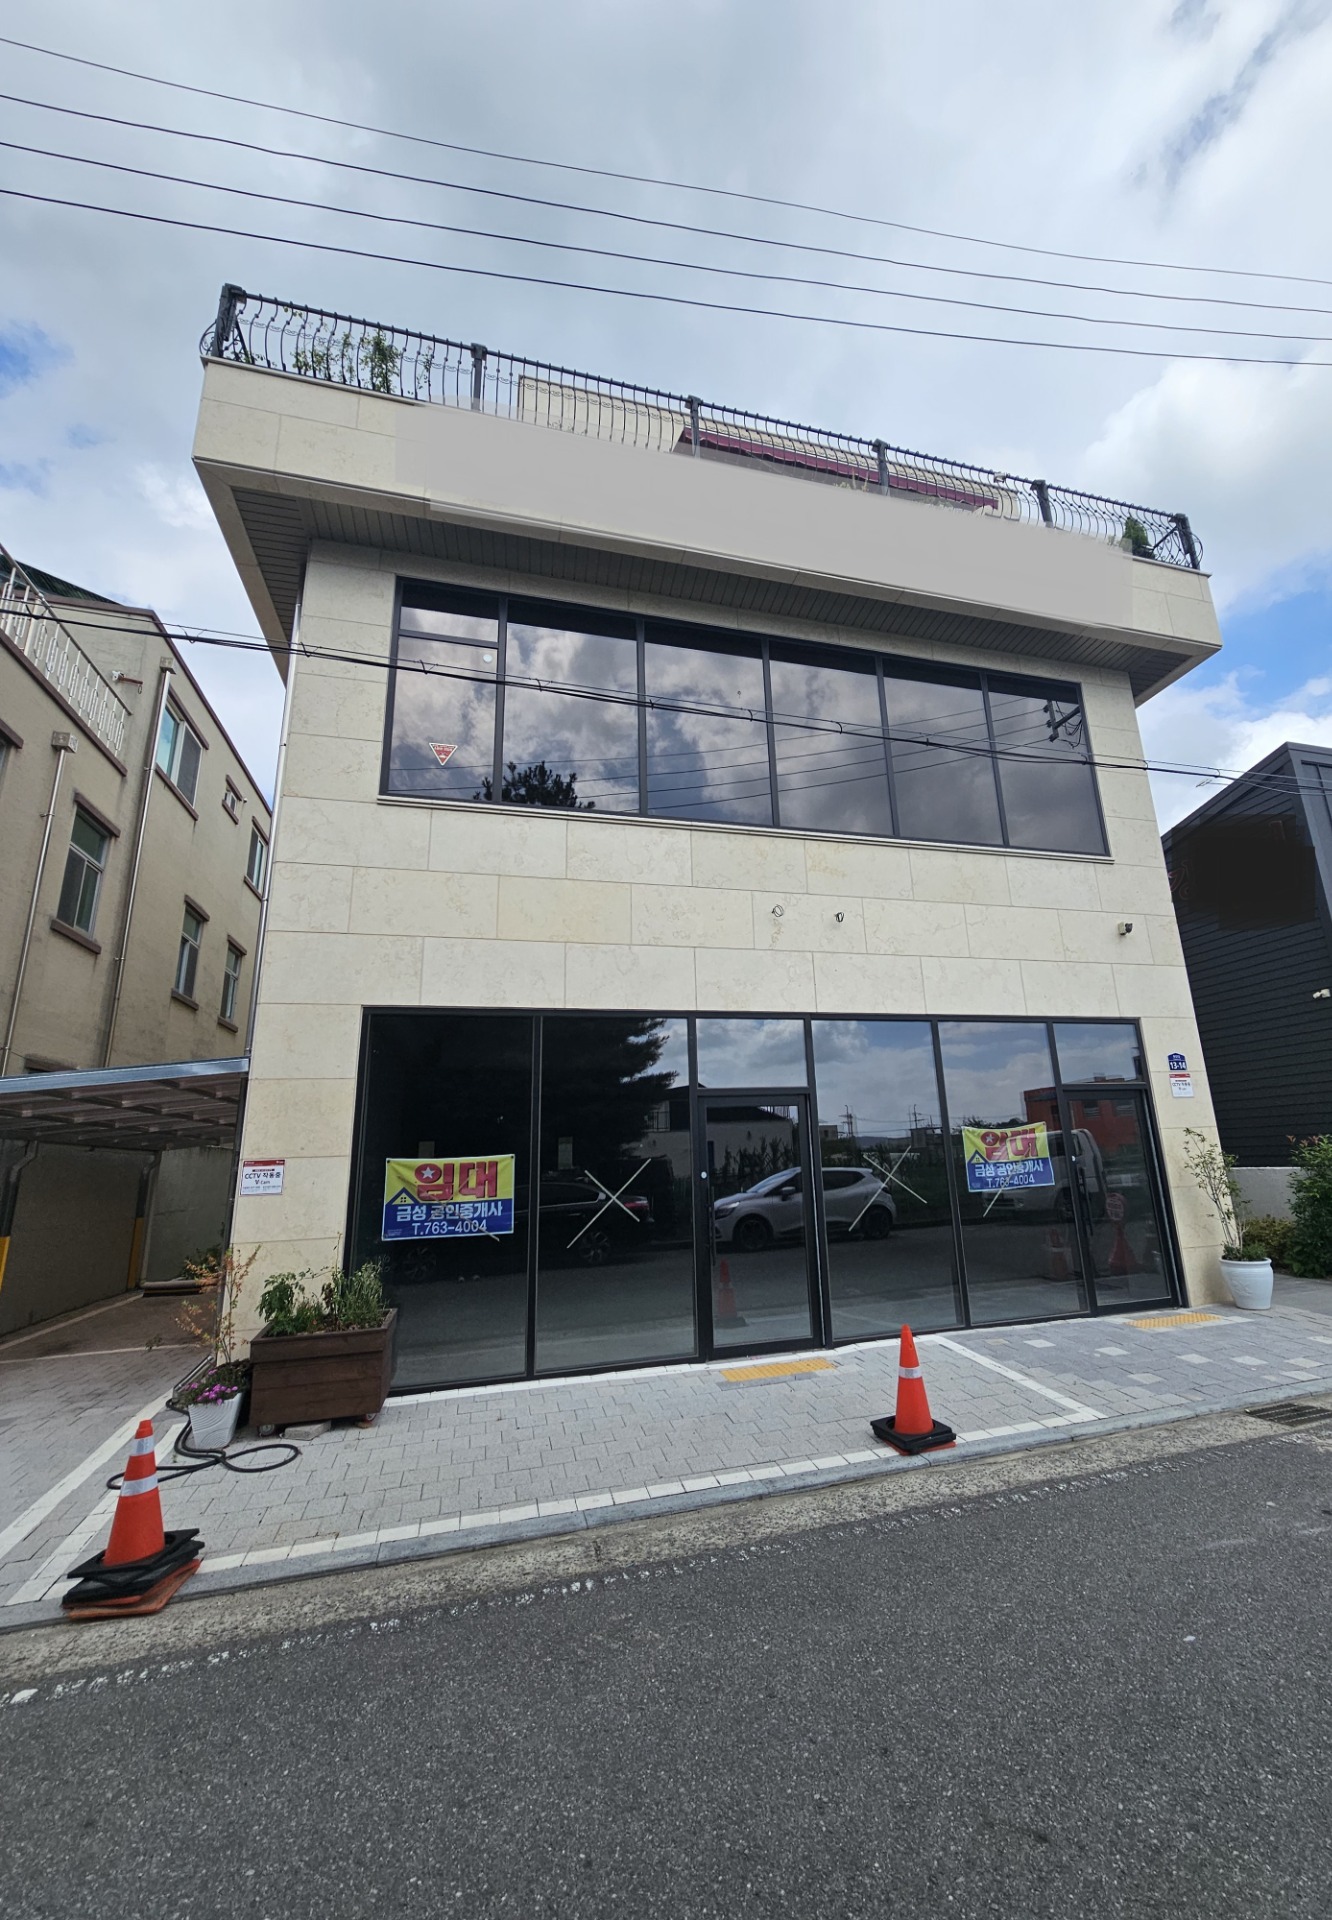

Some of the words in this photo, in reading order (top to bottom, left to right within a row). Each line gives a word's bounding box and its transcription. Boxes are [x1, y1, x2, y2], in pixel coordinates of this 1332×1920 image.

[980, 1128, 1038, 1161] 임대
[975, 1164, 995, 1177] 금성
[415, 1161, 498, 1201] 임대
[987, 1174, 1035, 1188] T.763-4004
[397, 1205, 427, 1221] 금성
[431, 1201, 503, 1219] 공인중개사
[412, 1219, 487, 1235] T.763-4004
